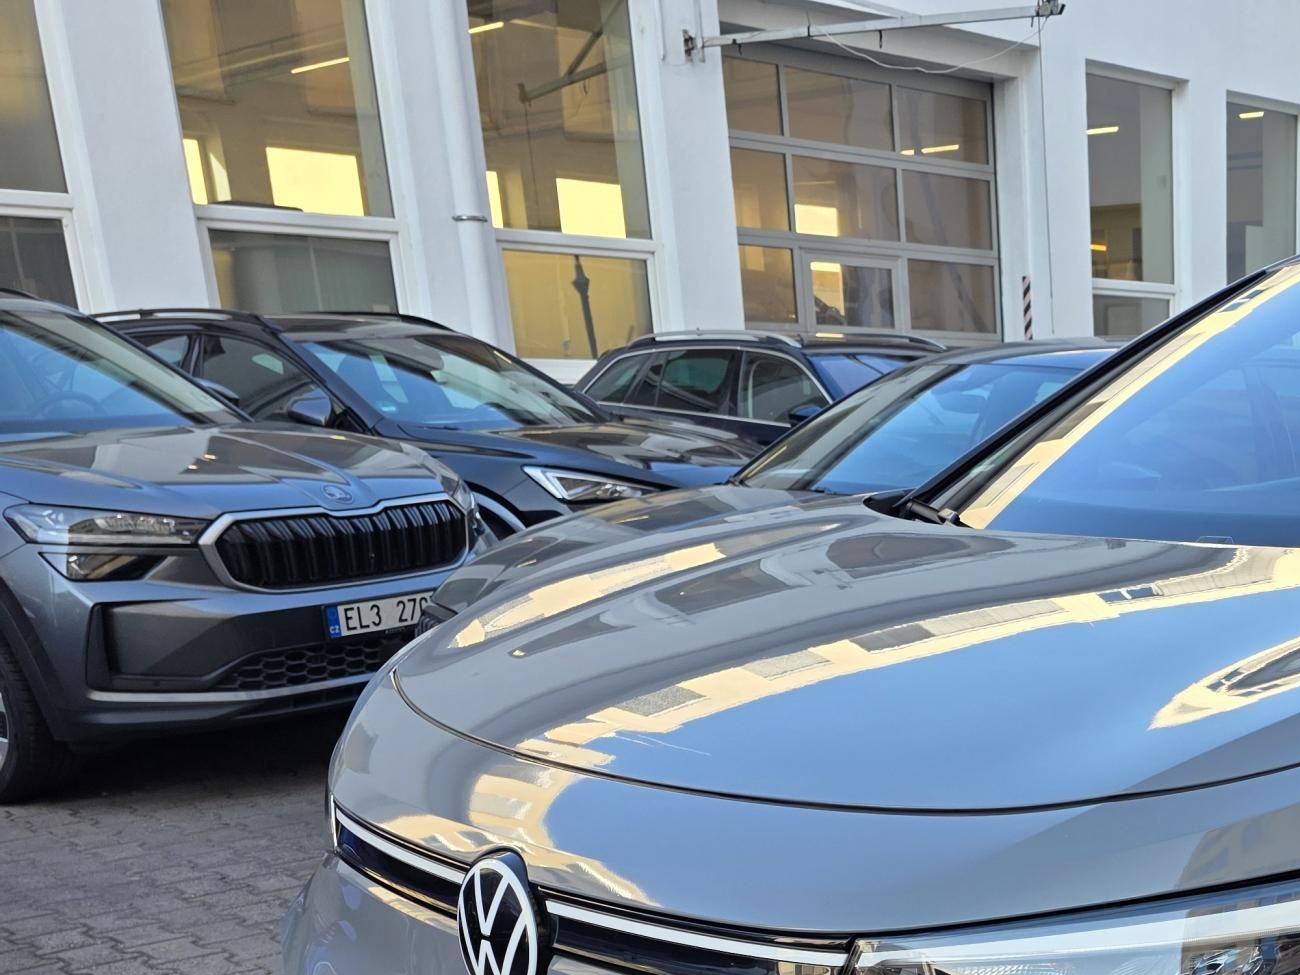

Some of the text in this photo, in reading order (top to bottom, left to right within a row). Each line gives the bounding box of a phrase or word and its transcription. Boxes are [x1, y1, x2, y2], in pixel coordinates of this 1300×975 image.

[343, 595, 433, 632] EL3 27
[329, 625, 341, 635] CZ
